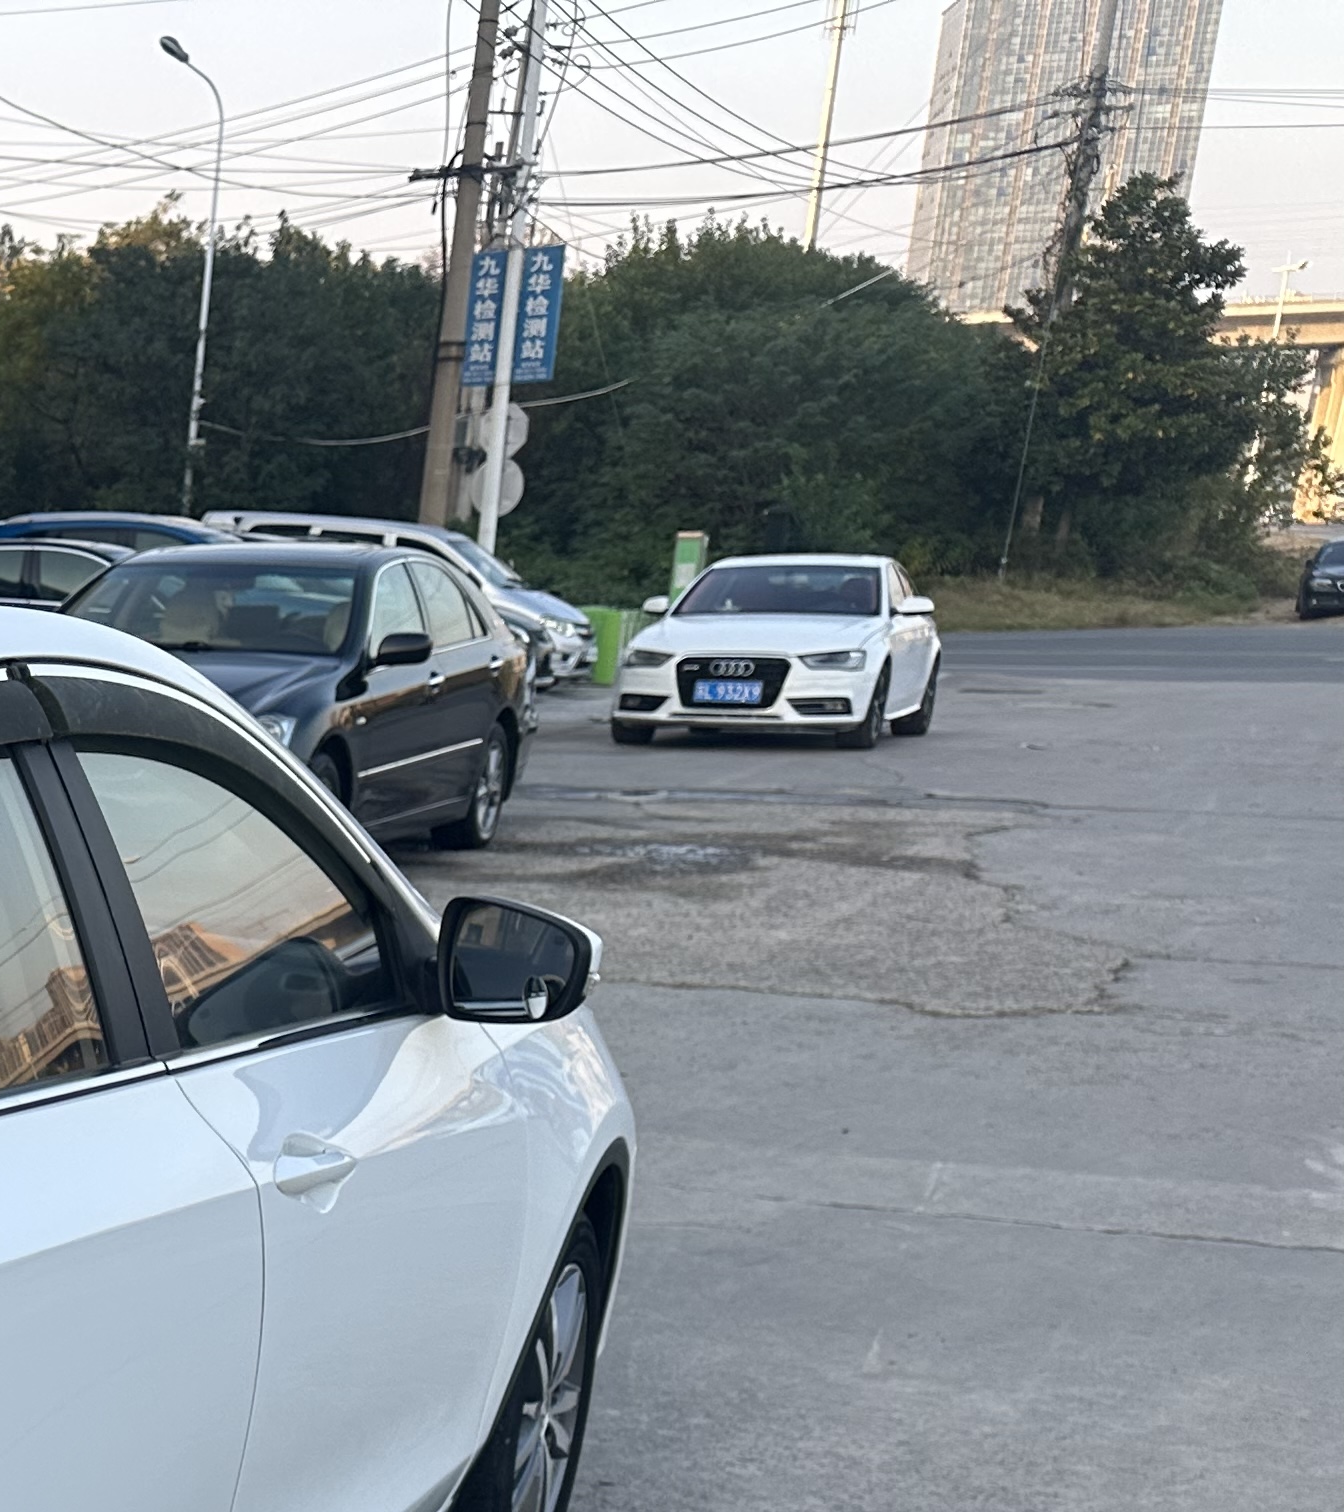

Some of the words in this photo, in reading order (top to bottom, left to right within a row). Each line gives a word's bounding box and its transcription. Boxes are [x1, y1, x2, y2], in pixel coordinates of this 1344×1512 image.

[469, 256, 501, 362] 九华检测站
[520, 251, 553, 360] 九华检测站
